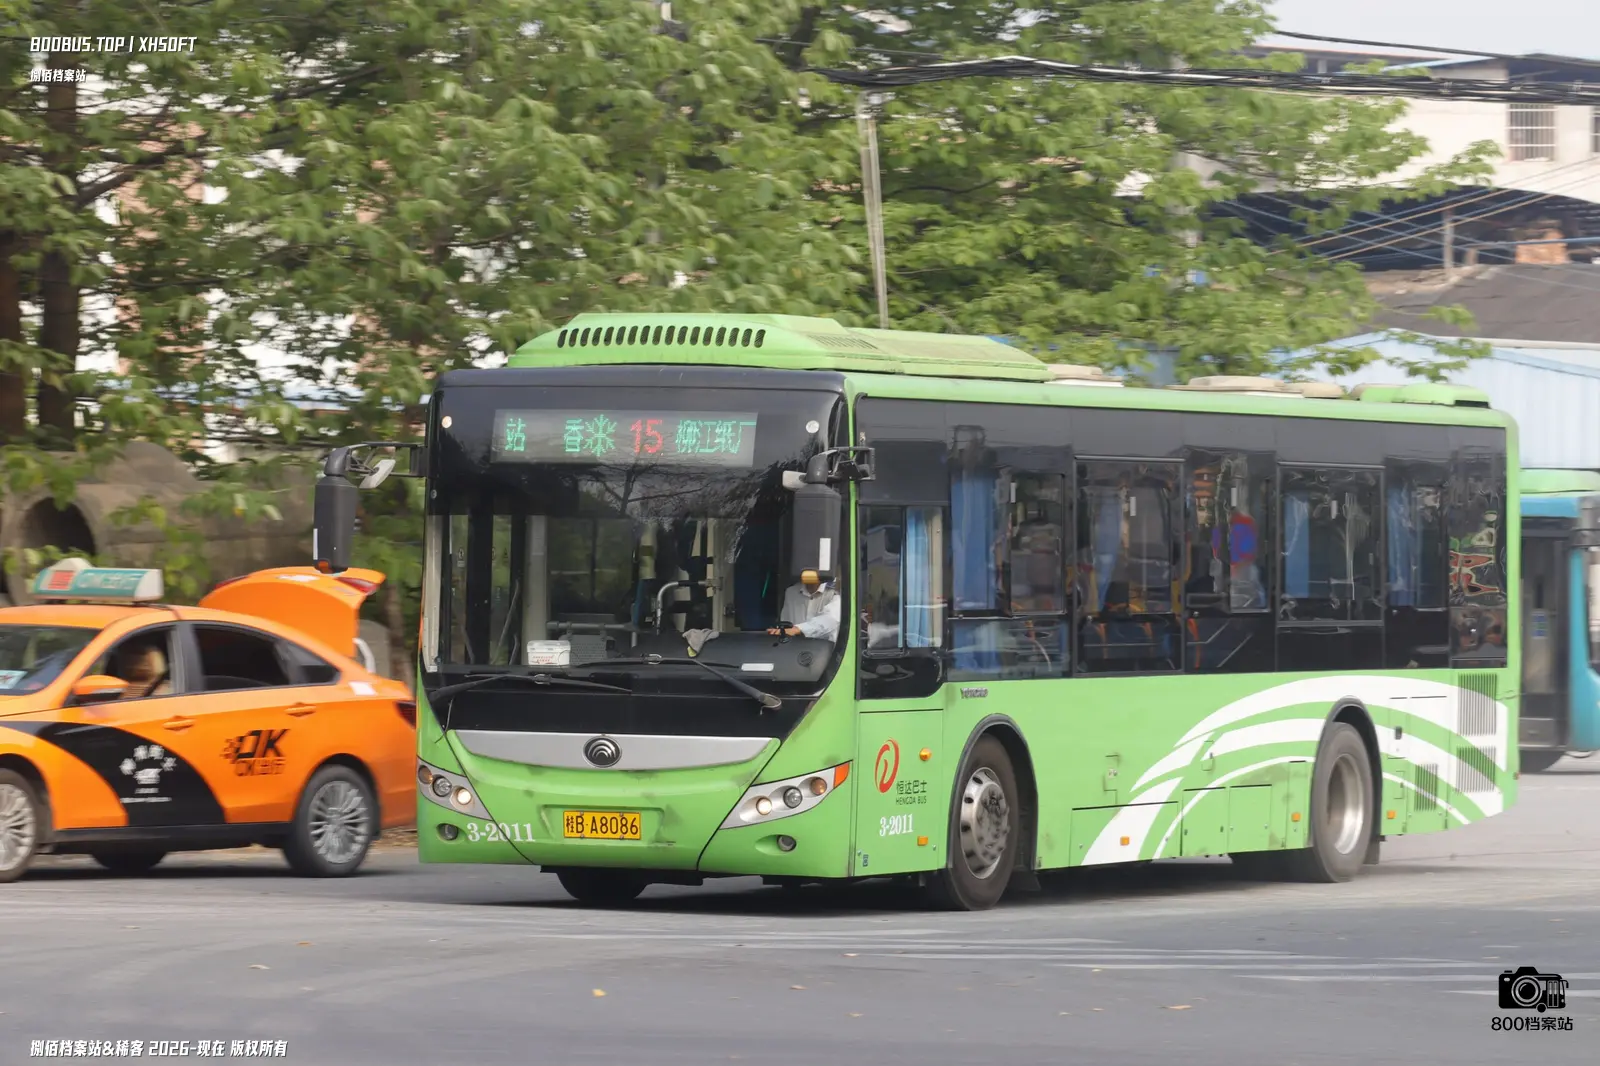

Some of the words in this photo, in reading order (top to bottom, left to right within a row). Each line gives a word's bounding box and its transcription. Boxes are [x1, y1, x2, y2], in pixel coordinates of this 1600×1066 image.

[505, 418, 527, 452] 站
[630, 419, 663, 454] 15
[896, 779, 928, 795] 恒达巴士
[917, 795, 927, 804] BUS
[466, 822, 535, 843] 3-2011
[879, 813, 914, 837] 3-2011
